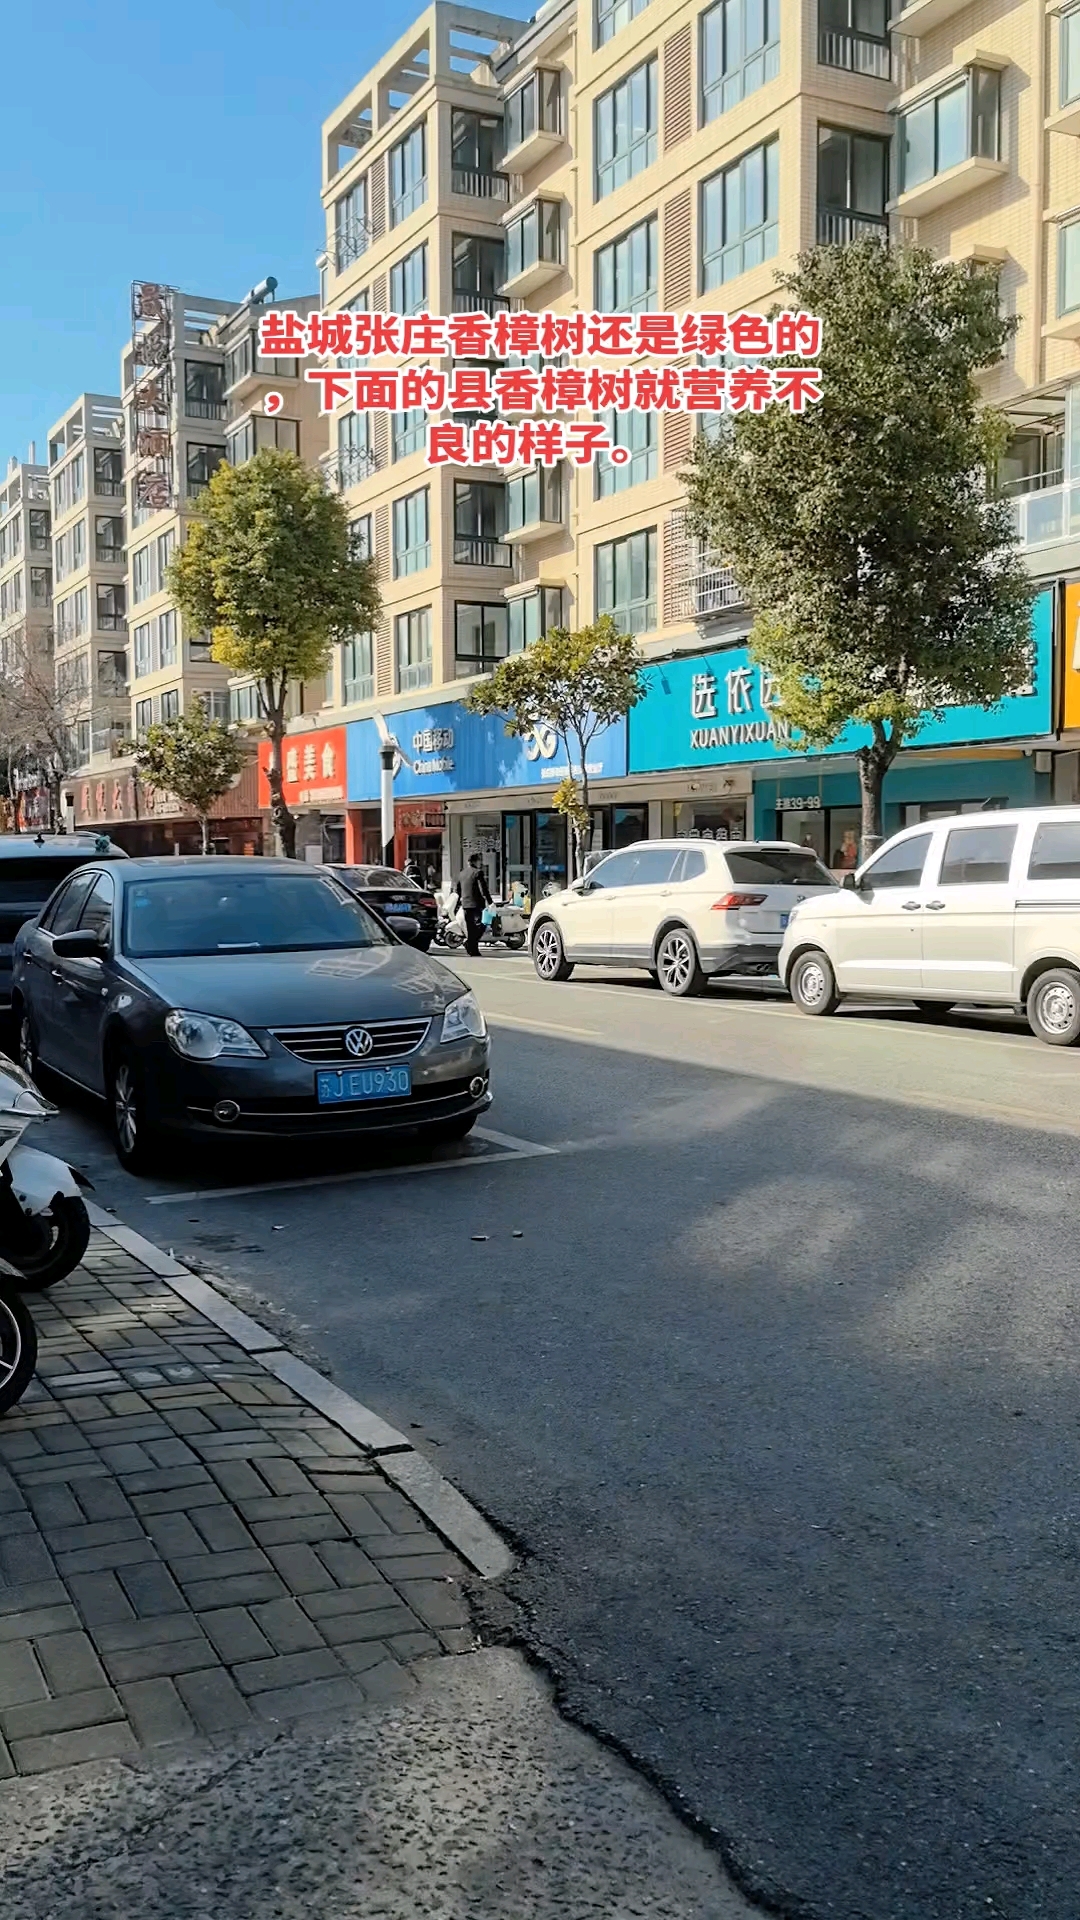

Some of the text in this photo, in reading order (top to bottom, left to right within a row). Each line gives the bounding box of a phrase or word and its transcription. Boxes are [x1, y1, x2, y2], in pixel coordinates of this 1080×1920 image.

[412, 727, 454, 754] 中国移动
[689, 717, 790, 748] XUANYIXUAN
